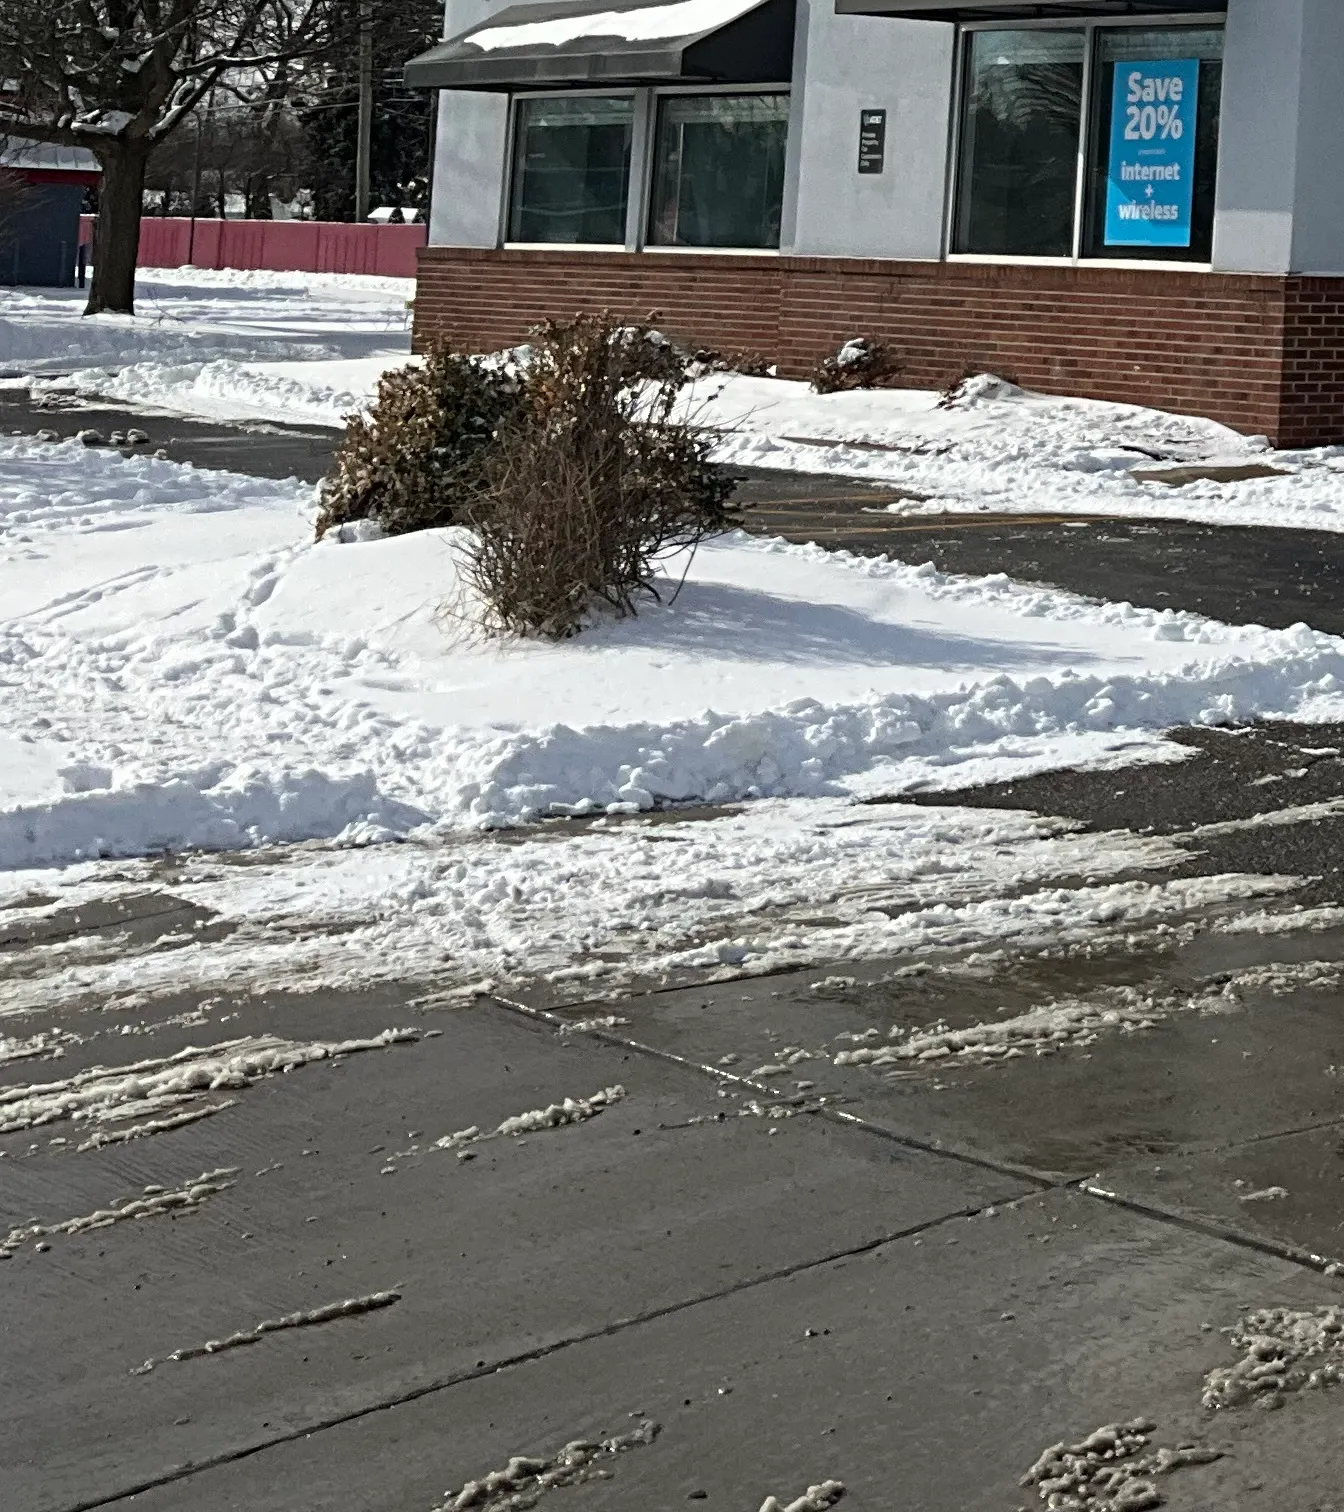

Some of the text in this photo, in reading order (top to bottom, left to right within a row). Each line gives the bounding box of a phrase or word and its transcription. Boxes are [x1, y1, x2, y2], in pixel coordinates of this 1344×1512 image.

[1127, 71, 1183, 103] Save
[1124, 104, 1183, 140] 20%
[1121, 161, 1181, 181] internet
[1119, 200, 1178, 221] wireless
